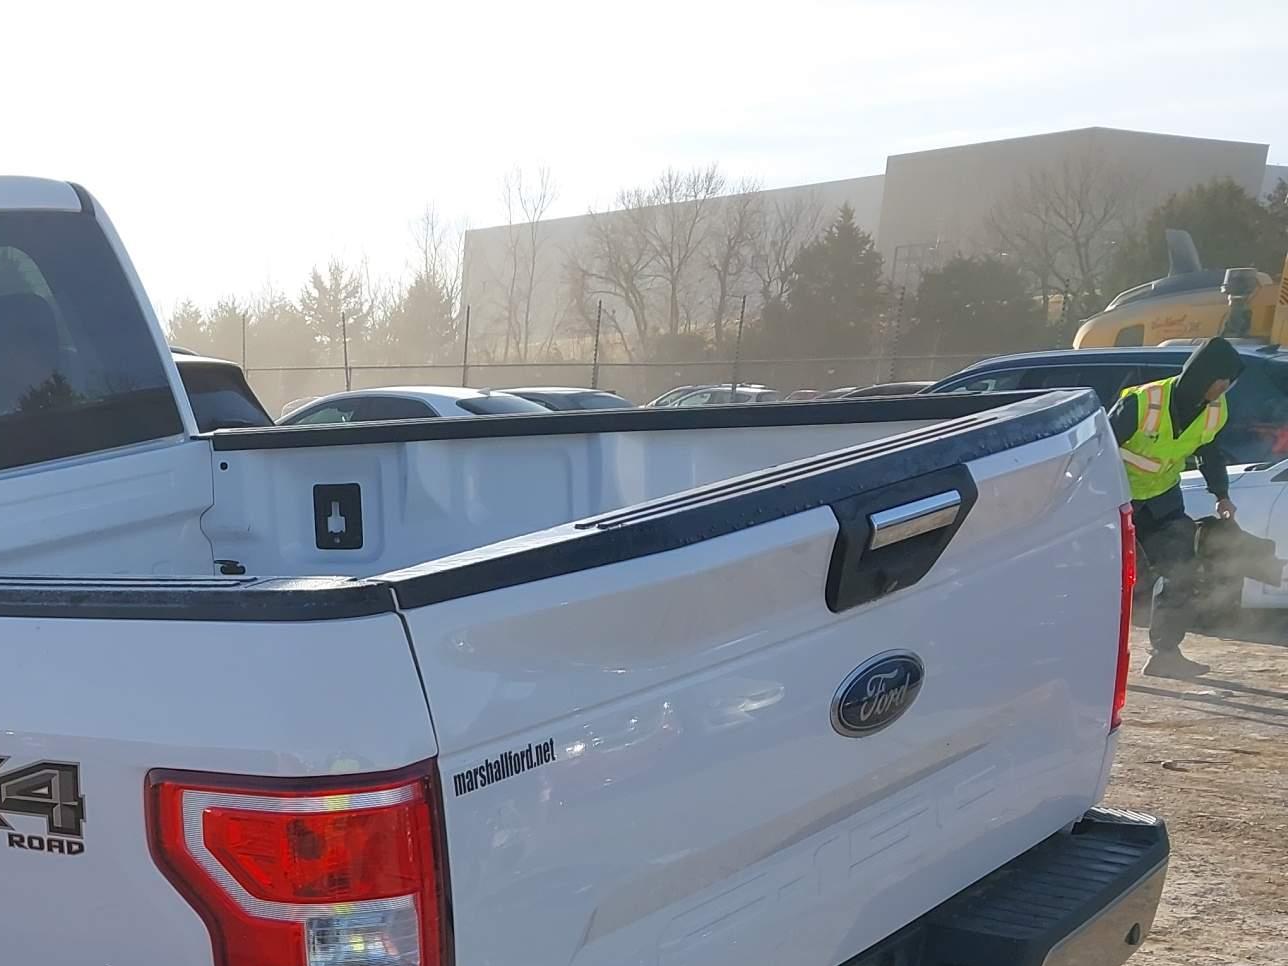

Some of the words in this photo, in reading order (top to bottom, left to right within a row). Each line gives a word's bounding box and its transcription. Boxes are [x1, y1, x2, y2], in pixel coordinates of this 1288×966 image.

[859, 668, 912, 721] Ford
[453, 737, 556, 797] marshallford.net
[7, 832, 85, 856] ROAD
